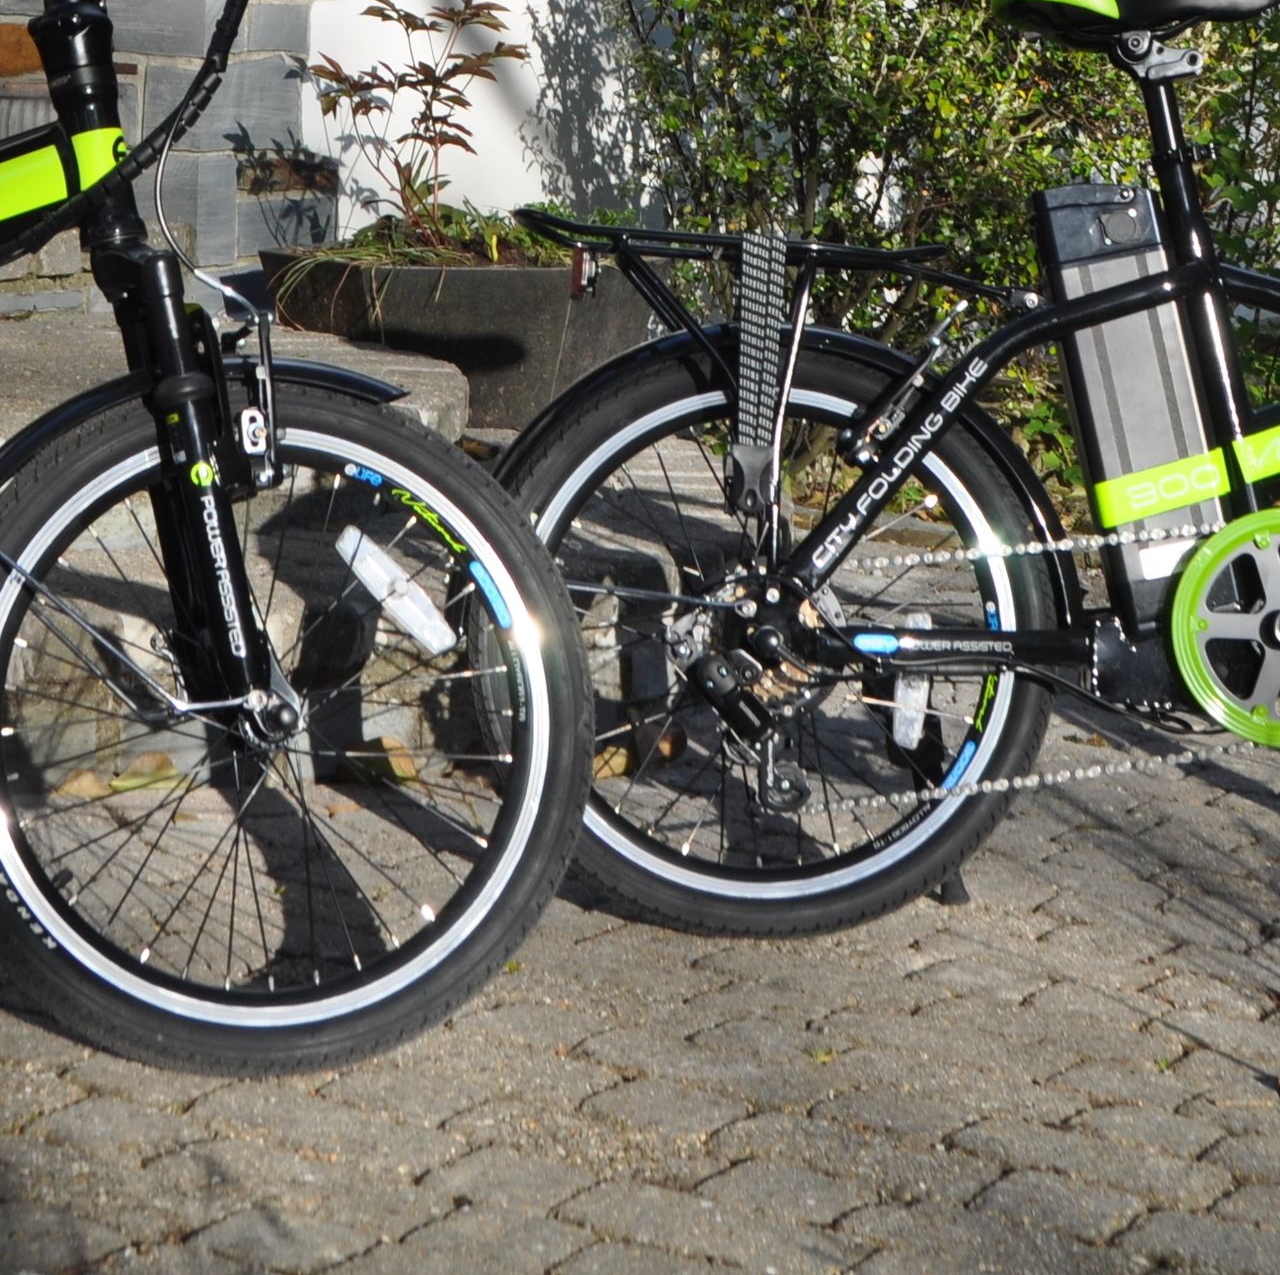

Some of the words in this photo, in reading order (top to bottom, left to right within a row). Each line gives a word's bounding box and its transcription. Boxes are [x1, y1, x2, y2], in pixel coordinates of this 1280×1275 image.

[811, 512, 857, 569] CITY
[857, 412, 944, 516] FOLDING
[940, 356, 989, 413] BIKE
[1126, 464, 1220, 509] 300
[200, 494, 227, 569] POWER
[216, 568, 247, 659] ASSISTED
[953, 640, 1013, 653] ASSISTED
